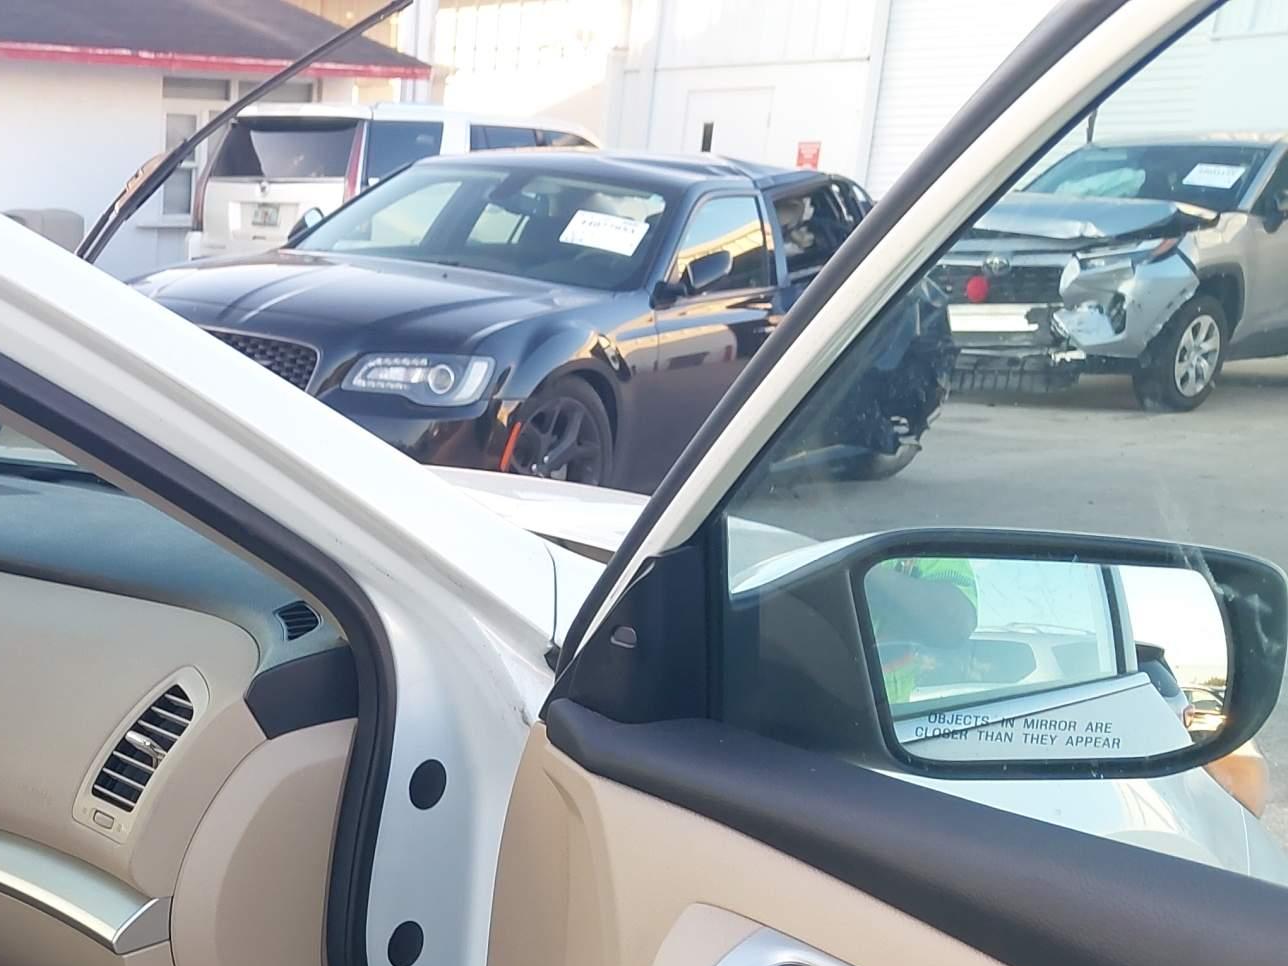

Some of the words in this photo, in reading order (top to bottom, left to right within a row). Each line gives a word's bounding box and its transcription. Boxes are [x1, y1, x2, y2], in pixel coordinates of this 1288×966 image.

[927, 713, 990, 726] OBJECTS
[1001, 717, 1016, 729] IN
[1023, 718, 1077, 732] MIRROR
[1085, 721, 1113, 734] ARE
[915, 726, 969, 740] CLOSER
[977, 730, 1014, 743] THAN
[1023, 733, 1057, 746] THEY
[1065, 735, 1121, 750] APPEAR
